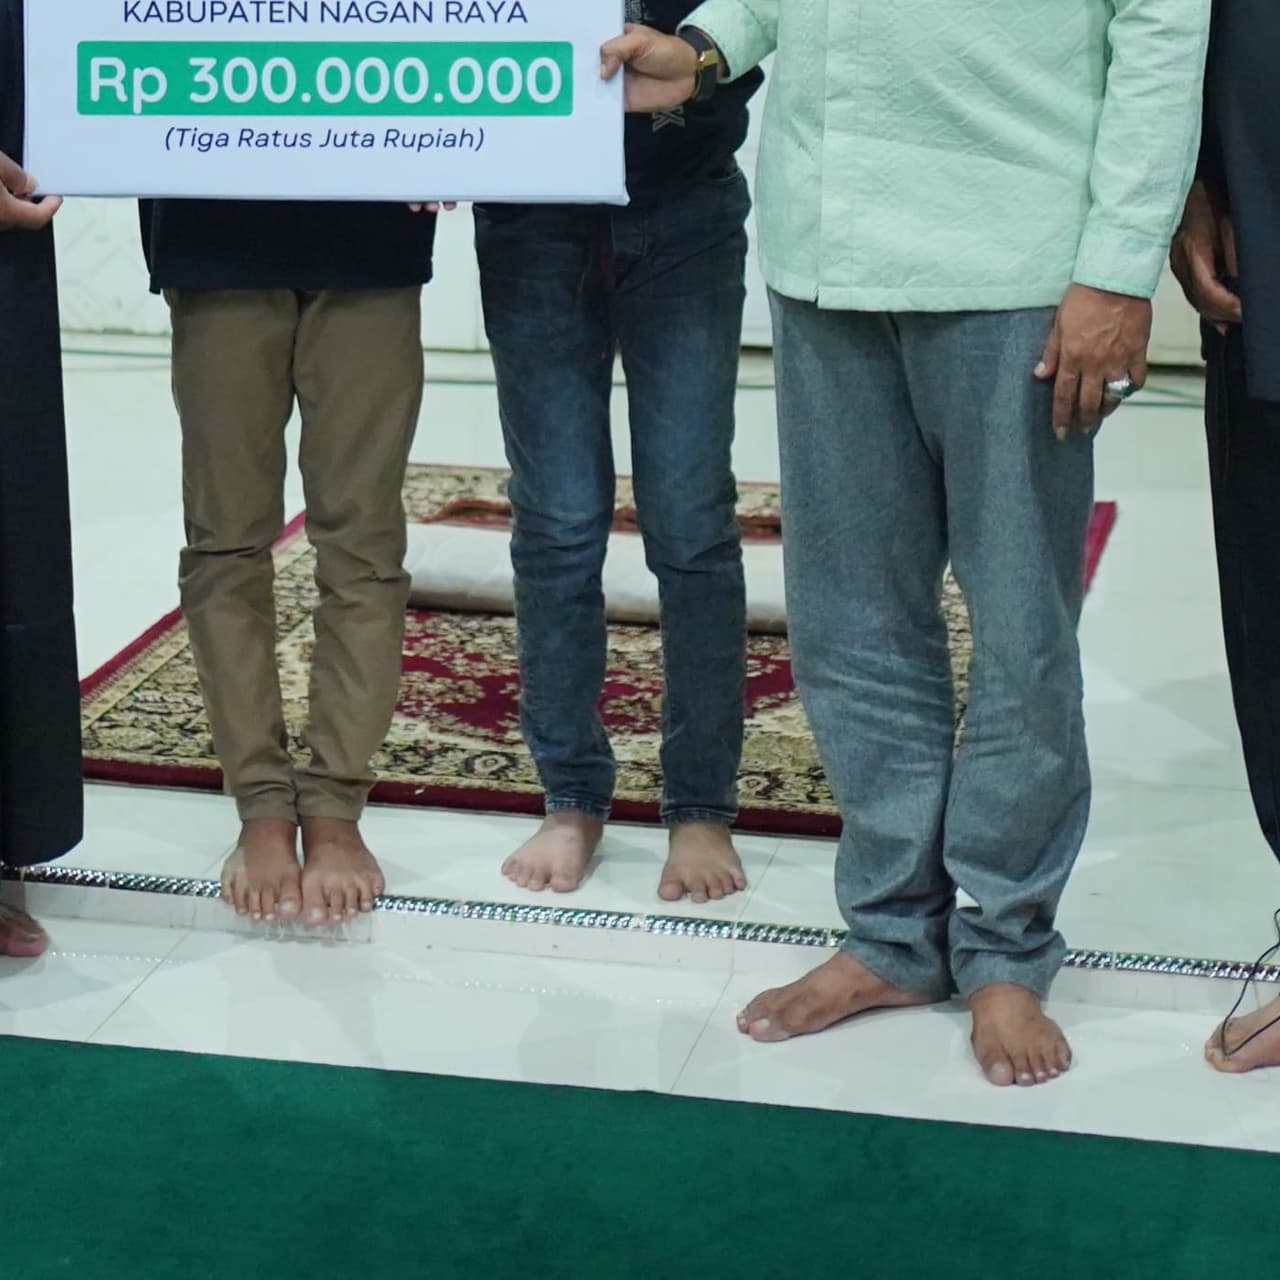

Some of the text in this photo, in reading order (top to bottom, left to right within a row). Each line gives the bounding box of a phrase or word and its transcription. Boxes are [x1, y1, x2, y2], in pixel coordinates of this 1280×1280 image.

[123, 0, 528, 24] KABUPATEN NAGAN RAYA
[90, 56, 562, 114] Rp 300.000.000
[165, 126, 484, 152] (Tiga Ratus Juta Rupiah)
